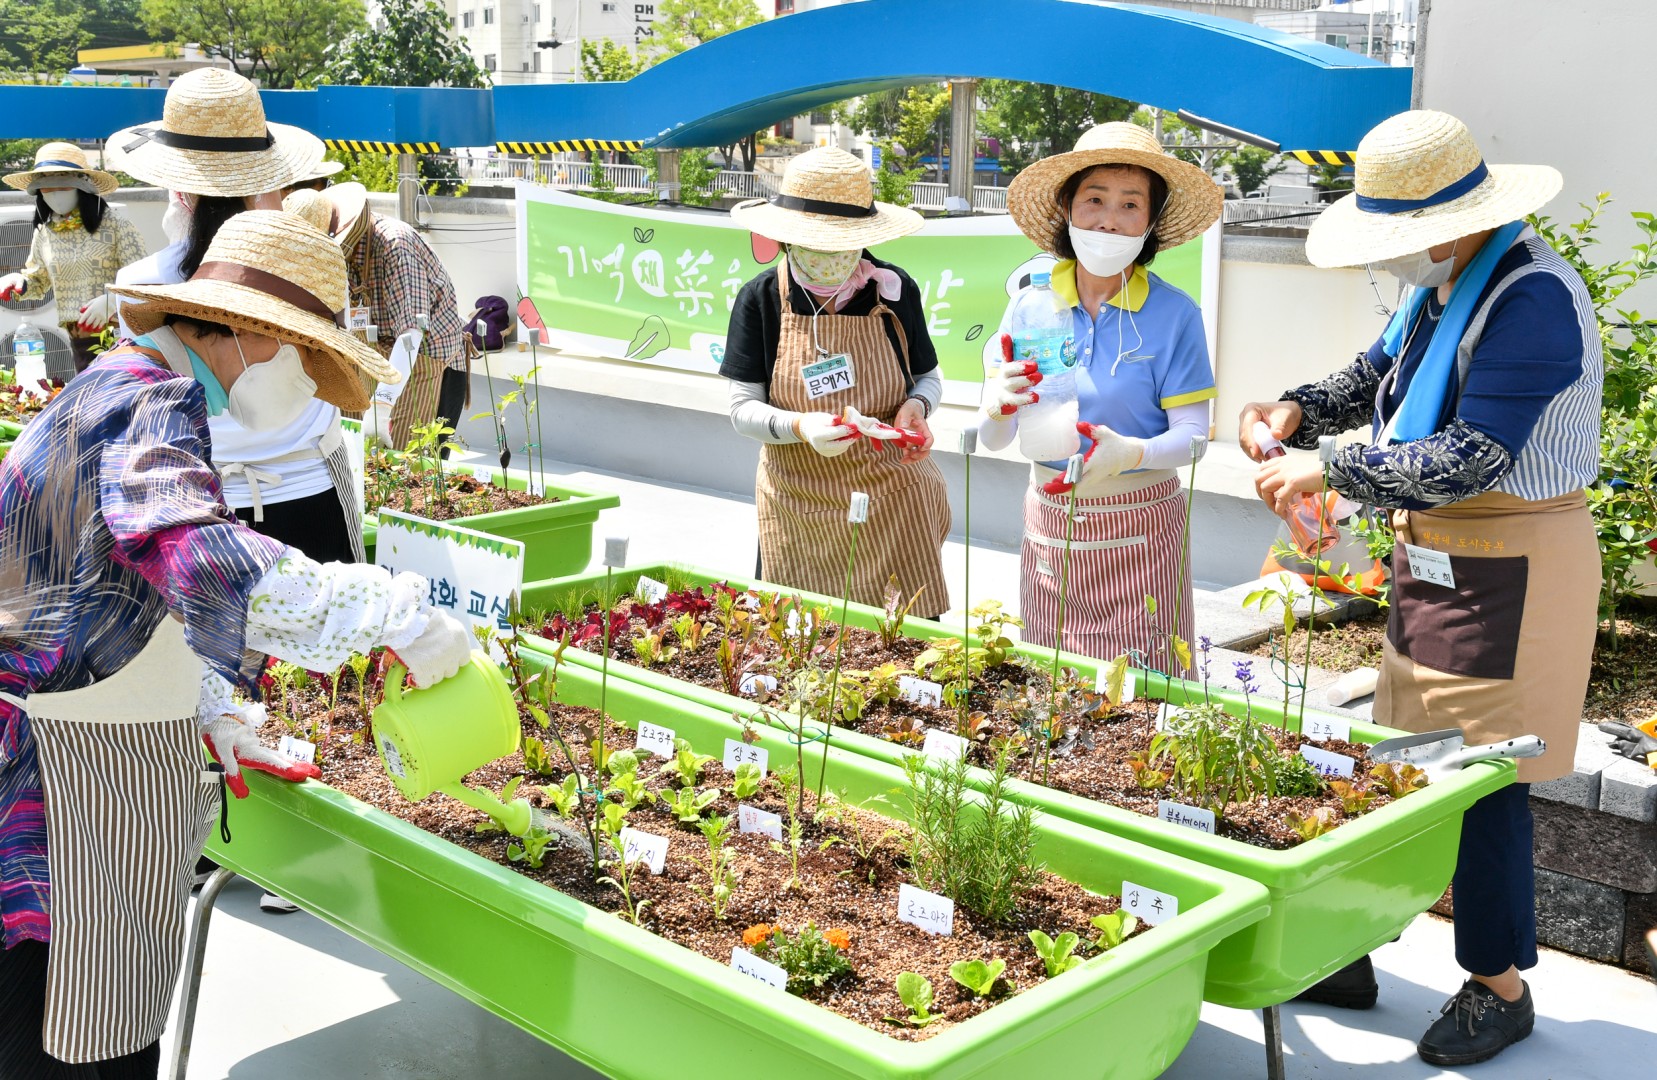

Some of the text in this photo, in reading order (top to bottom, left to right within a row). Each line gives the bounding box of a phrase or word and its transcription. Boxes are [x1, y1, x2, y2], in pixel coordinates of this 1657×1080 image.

[557, 243, 625, 303] 기억
[809, 370, 850, 396] 문애자
[467, 590, 512, 630] 교실
[1312, 722, 1333, 738] 고추
[733, 746, 758, 764] 상추
[908, 900, 949, 927] 로즈마리
[1129, 890, 1163, 914] 상추
